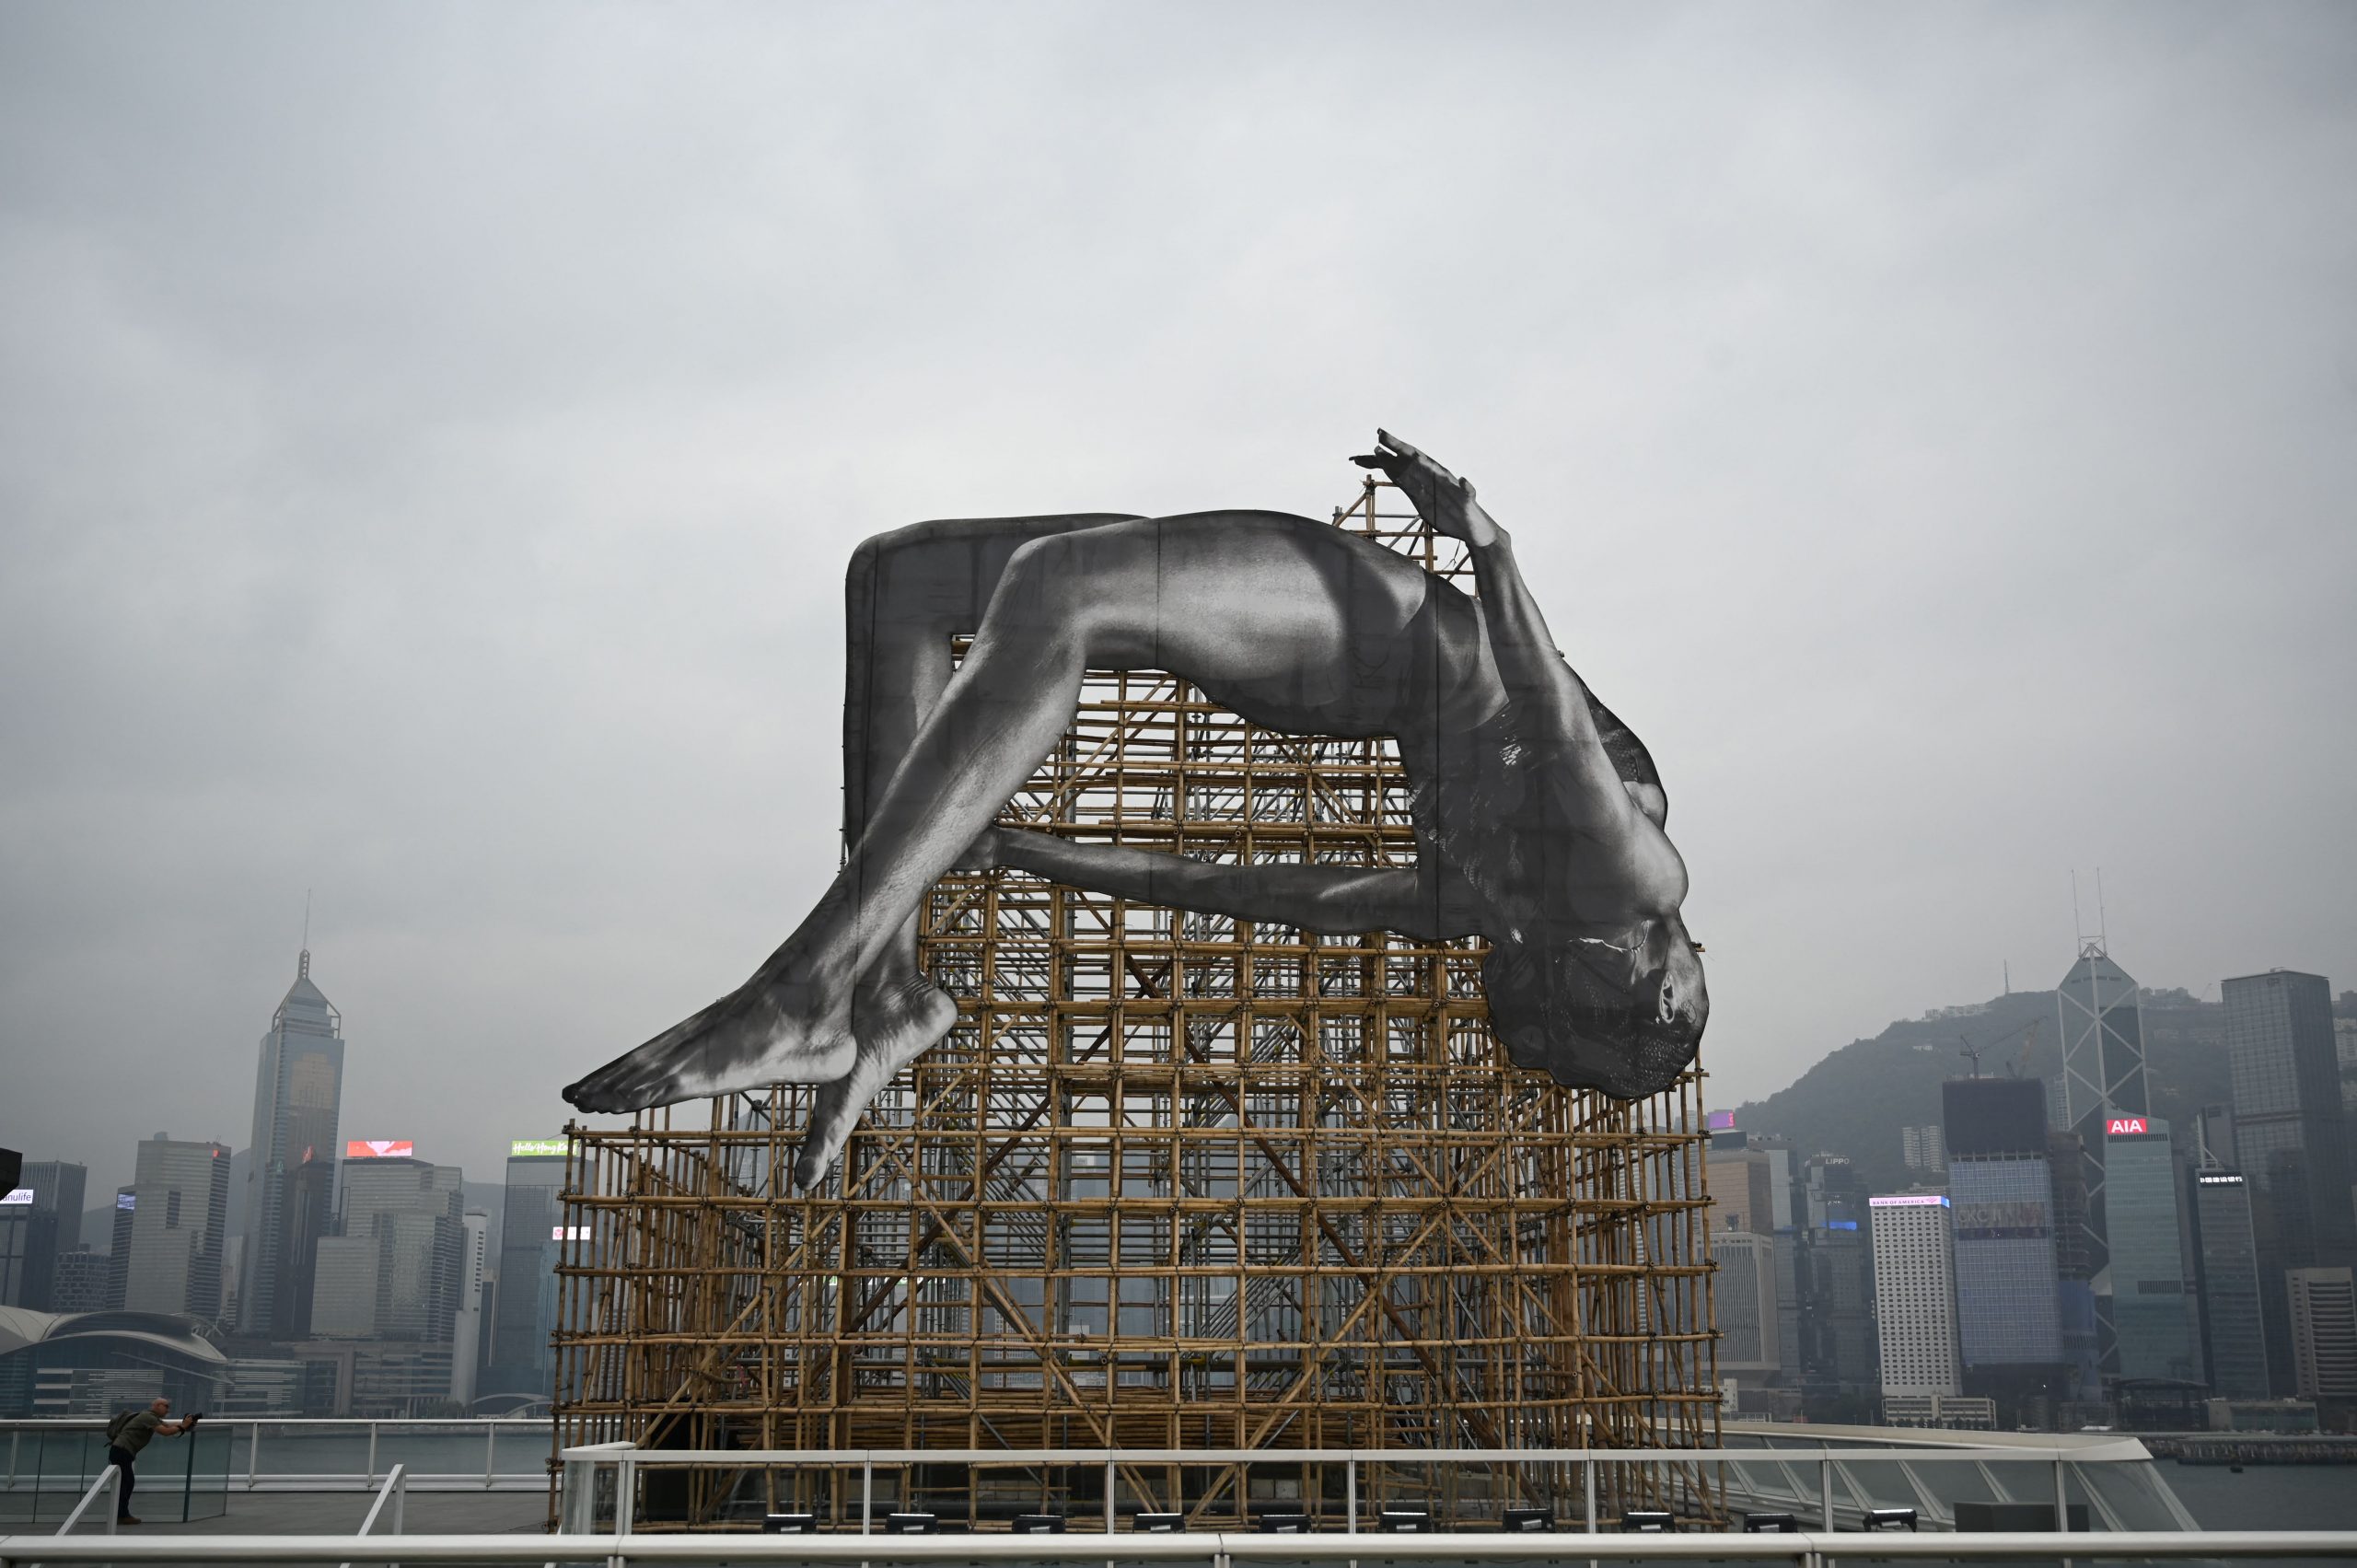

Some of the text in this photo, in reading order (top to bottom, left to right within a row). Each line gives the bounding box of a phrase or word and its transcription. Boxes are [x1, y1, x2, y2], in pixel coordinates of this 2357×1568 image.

[2111, 1120, 2142, 1133] AIA
[513, 1142, 577, 1156] Hello Hong Ko
[3, 1191, 31, 1202] anulife
